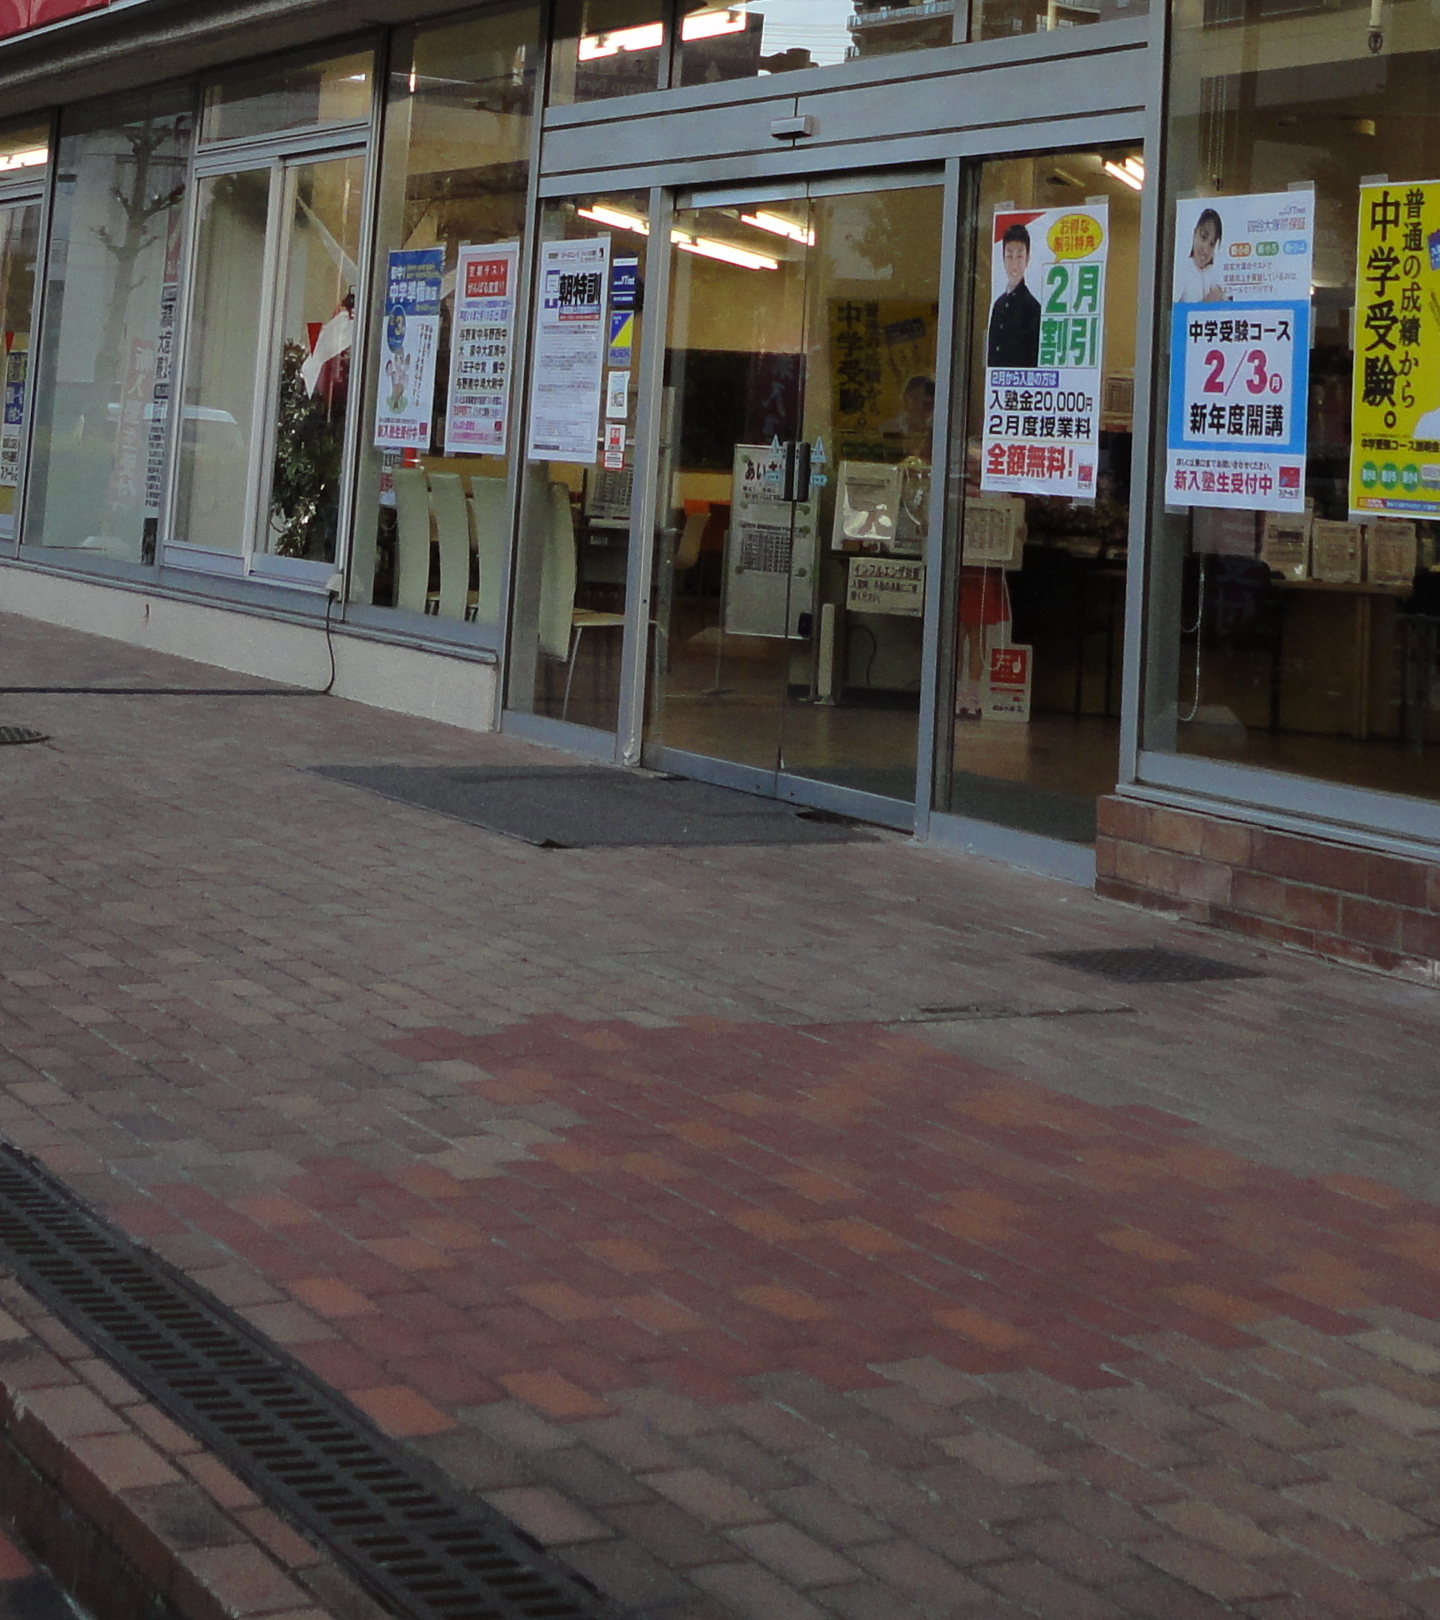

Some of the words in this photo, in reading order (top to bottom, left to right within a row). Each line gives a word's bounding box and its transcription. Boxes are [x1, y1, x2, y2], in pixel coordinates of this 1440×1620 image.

[1060, 218, 1091, 235] お得な
[1045, 264, 1100, 314] 2月
[1398, 187, 1426, 409] 普通の成績から
[1362, 189, 1402, 430] 中学受験。
[1040, 315, 1096, 367] 割引
[1189, 320, 1291, 343] 中学受験コース
[989, 414, 1091, 440] 2月度授業料
[1189, 402, 1284, 437] 新年度開講
[1173, 469, 1273, 496] 新入塾生受付中
